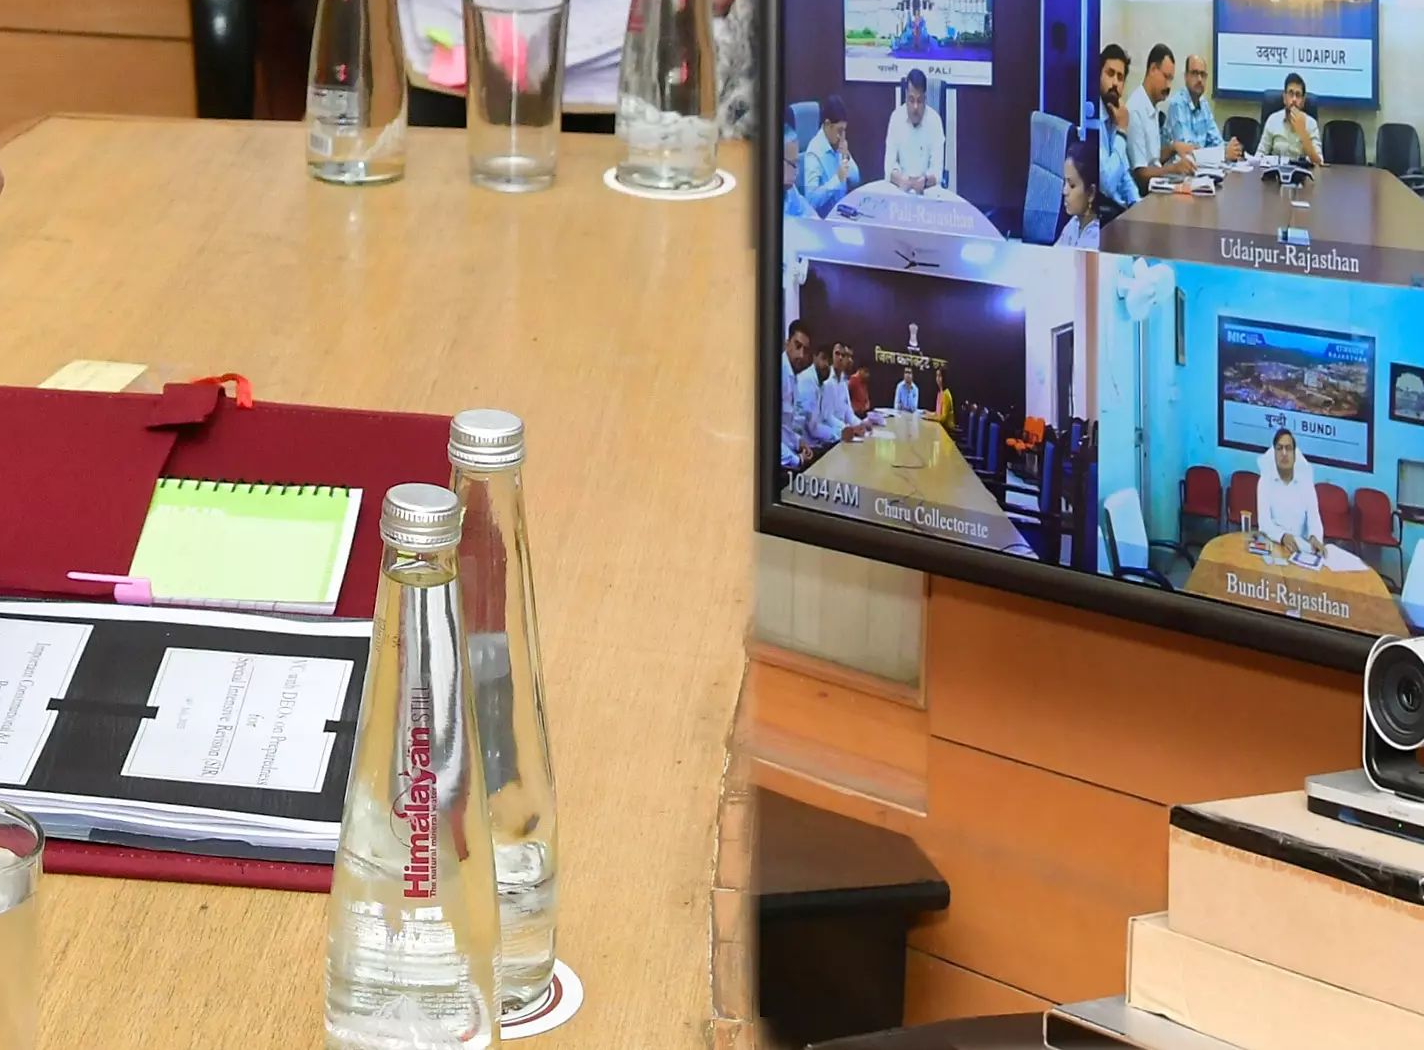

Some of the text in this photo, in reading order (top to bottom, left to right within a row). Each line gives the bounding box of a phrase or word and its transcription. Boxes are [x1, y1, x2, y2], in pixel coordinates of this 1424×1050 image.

[1256, 46, 1288, 64] उदयपुर
[1298, 48, 1346, 65] UDAIPUR
[928, 67, 952, 75] PALI
[1220, 237, 1359, 273] Udaipur-Rajasthan
[1227, 331, 1246, 344] NIC
[1301, 421, 1337, 437] BUNDI
[787, 471, 860, 507] 10:04 AM
[874, 497, 989, 539] Churu Collectorate
[1226, 572, 1350, 619] Bundi-Rajasthan
[224, 656, 254, 683] Special
[217, 684, 244, 723] Intensive
[274, 691, 298, 719] DEOs
[245, 713, 264, 728] for
[271, 721, 285, 733] on
[207, 724, 233, 756] Revision
[251, 735, 286, 786] Preparedness
[404, 687, 437, 898] Himalayan STILL
